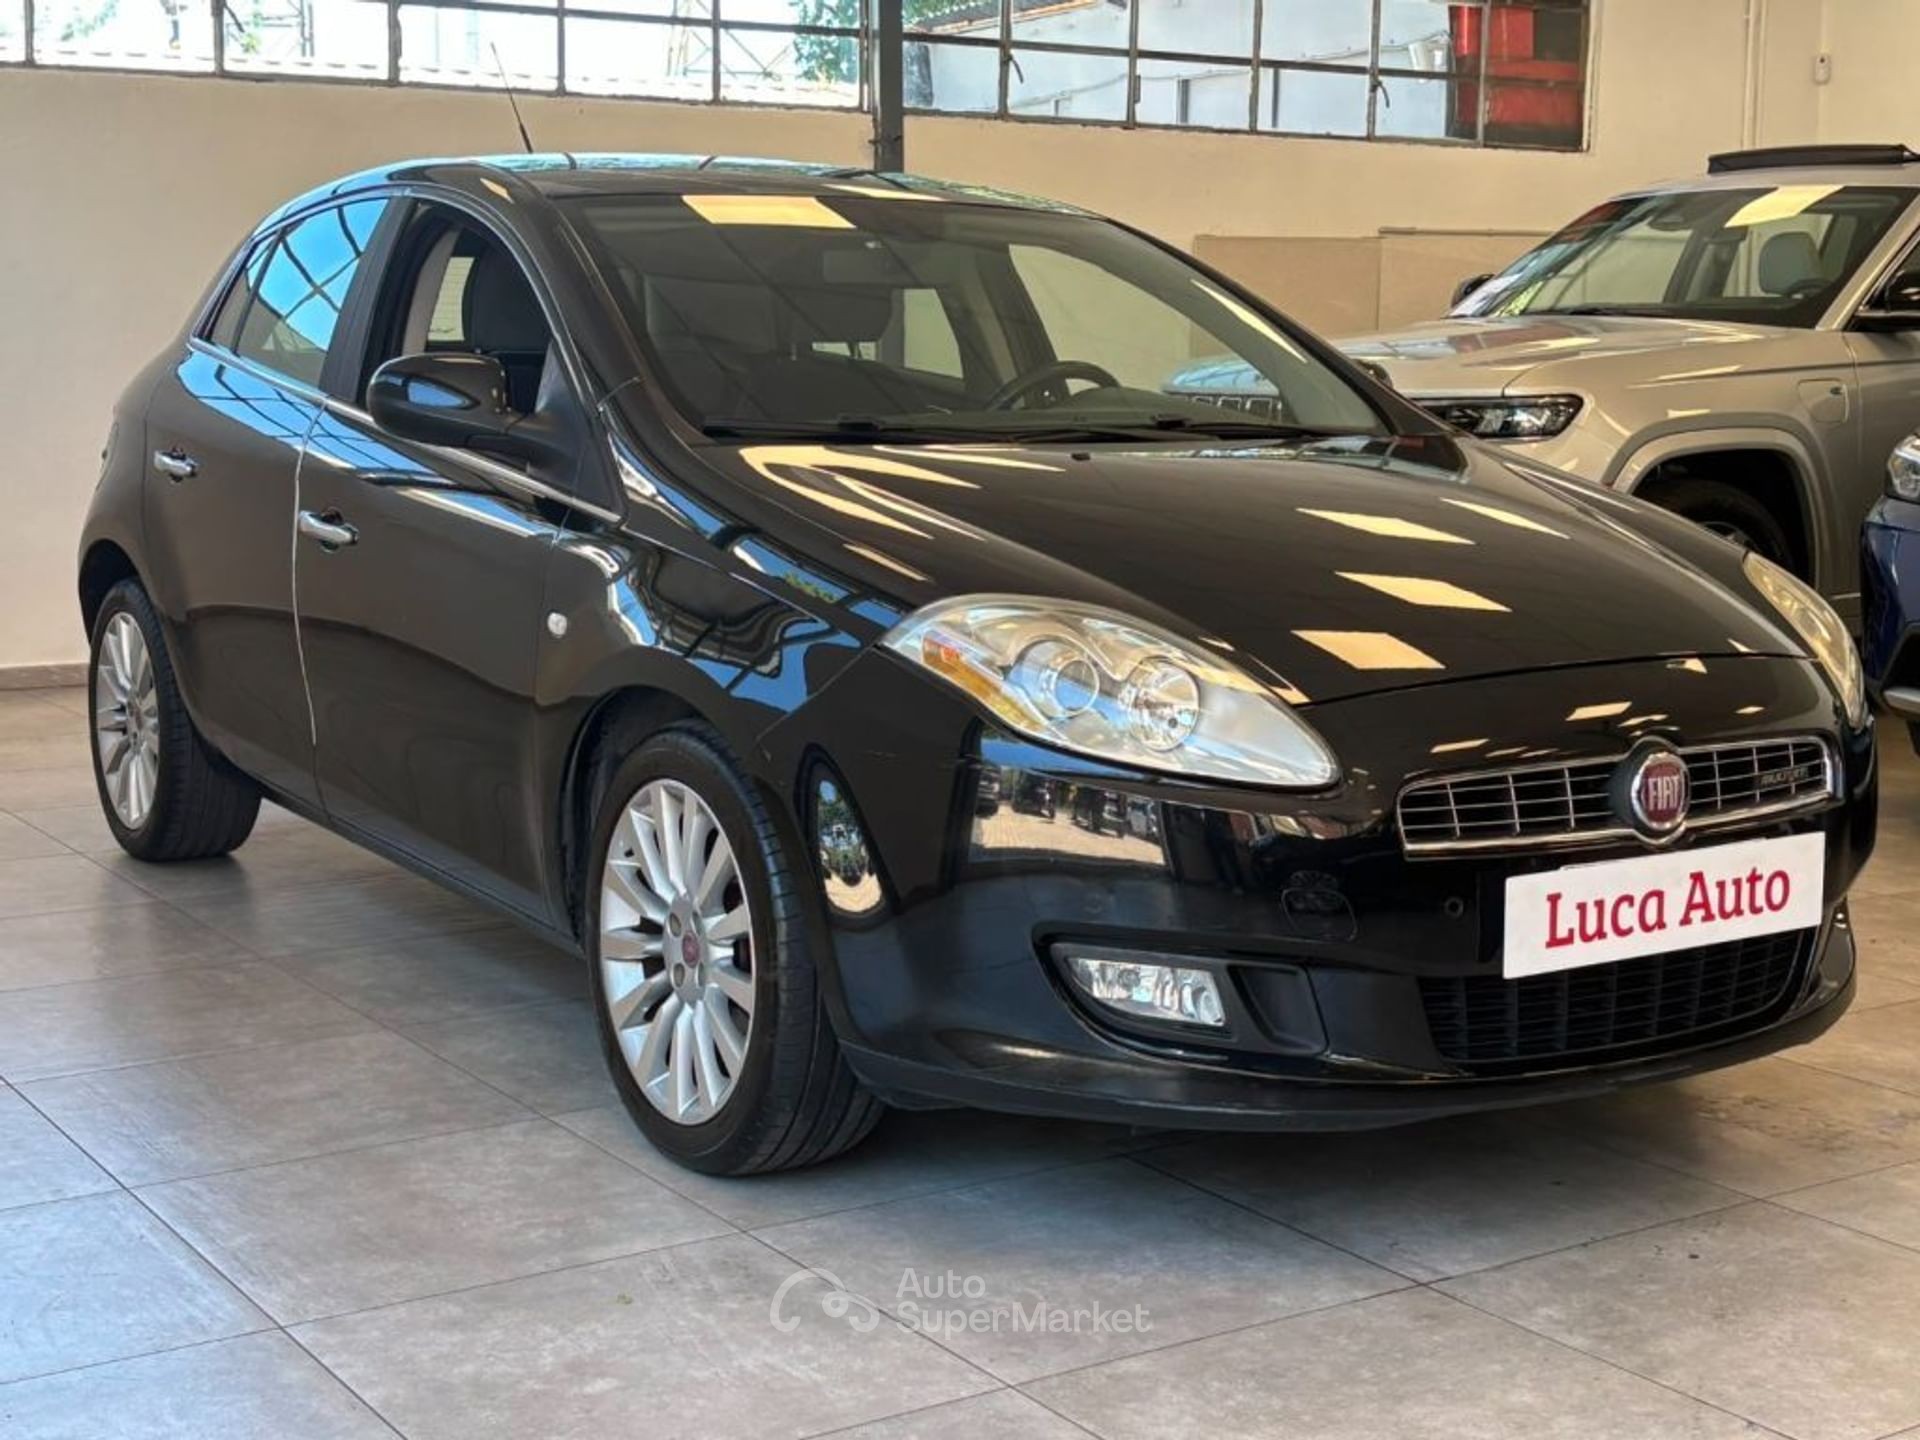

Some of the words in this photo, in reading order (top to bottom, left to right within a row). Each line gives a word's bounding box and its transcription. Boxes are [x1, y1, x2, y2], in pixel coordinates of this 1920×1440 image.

[1647, 774, 1680, 811] FIAT
[1545, 889, 1667, 949] Luca
[1678, 866, 1790, 927] Auto
